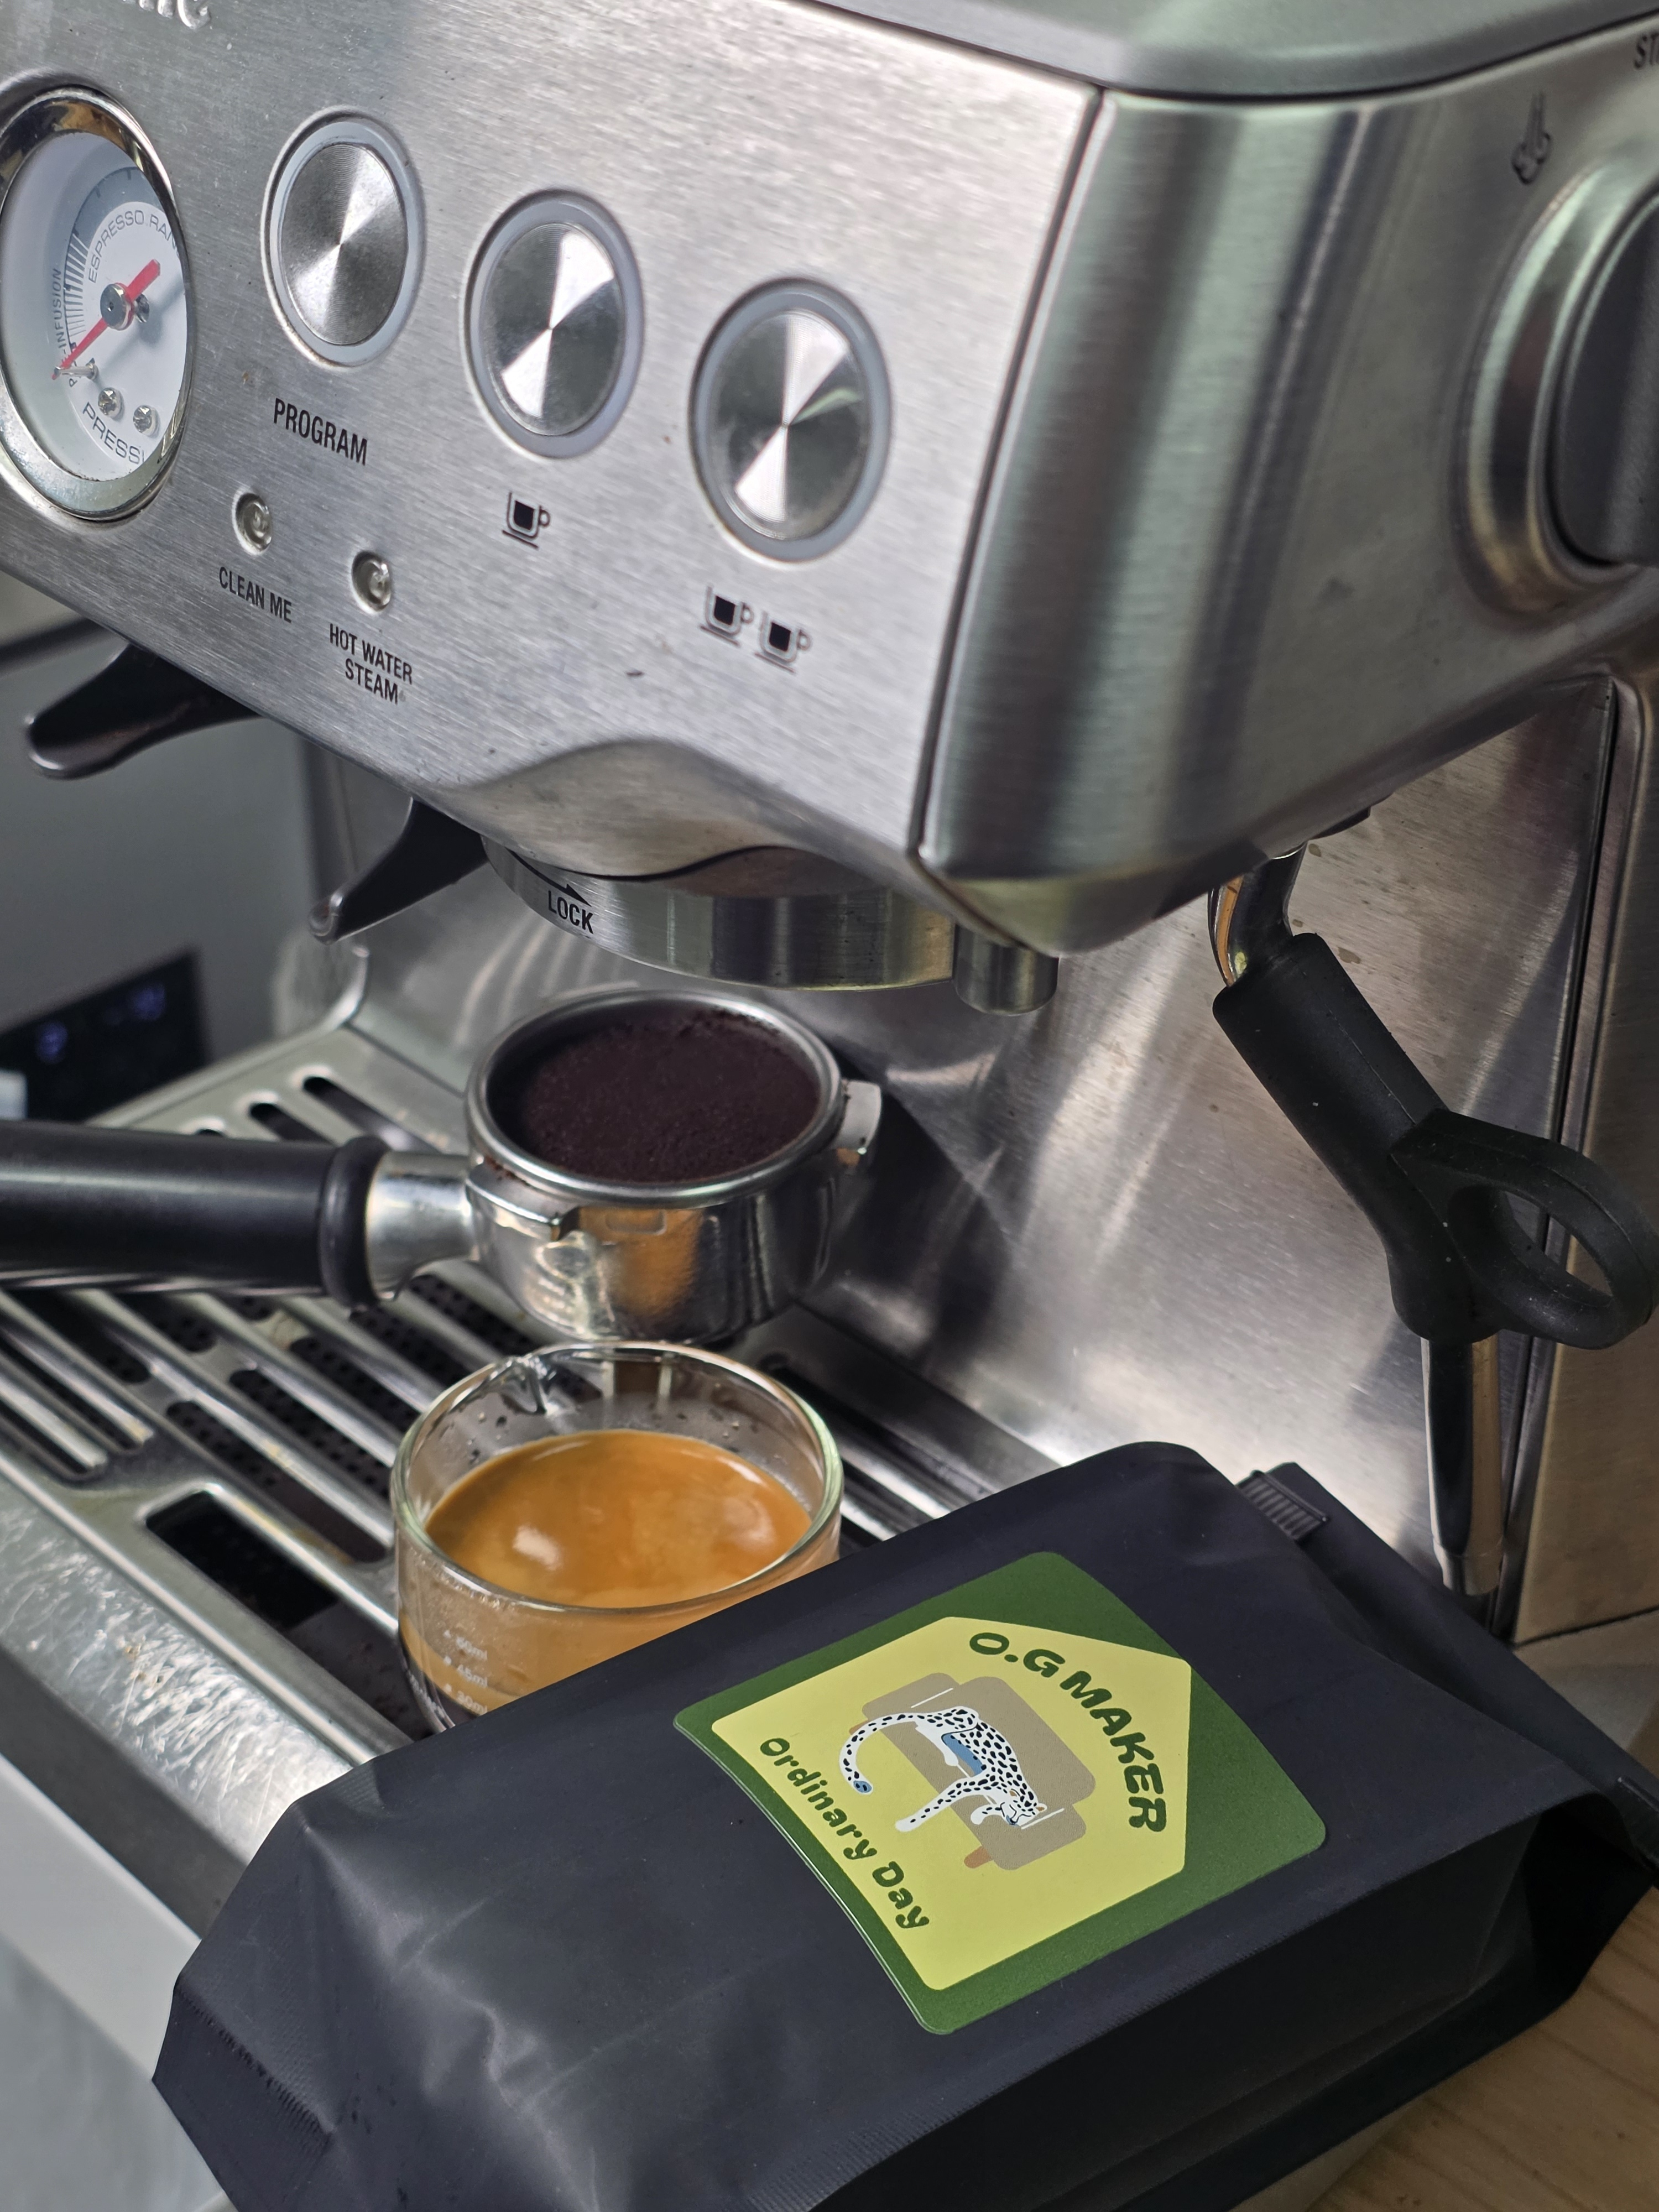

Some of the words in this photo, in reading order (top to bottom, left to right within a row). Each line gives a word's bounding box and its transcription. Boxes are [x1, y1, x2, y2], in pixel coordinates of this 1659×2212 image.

[88, 210, 144, 284] ESPRESSO
[149, 213, 180, 258] RAN
[53, 268, 79, 388] P-INFUSION
[274, 398, 368, 466] PROGRAM
[219, 566, 265, 609] CLEAN
[270, 592, 292, 623] ME
[330, 623, 357, 655] HOT
[362, 639, 413, 685] WATER
[345, 658, 398, 705] STEAM
[547, 890, 594, 935] LOCK
[457, 1664, 488, 1688] 45ml
[759, 1737, 877, 1861] Ordinary
[872, 1860, 930, 1931] Day
